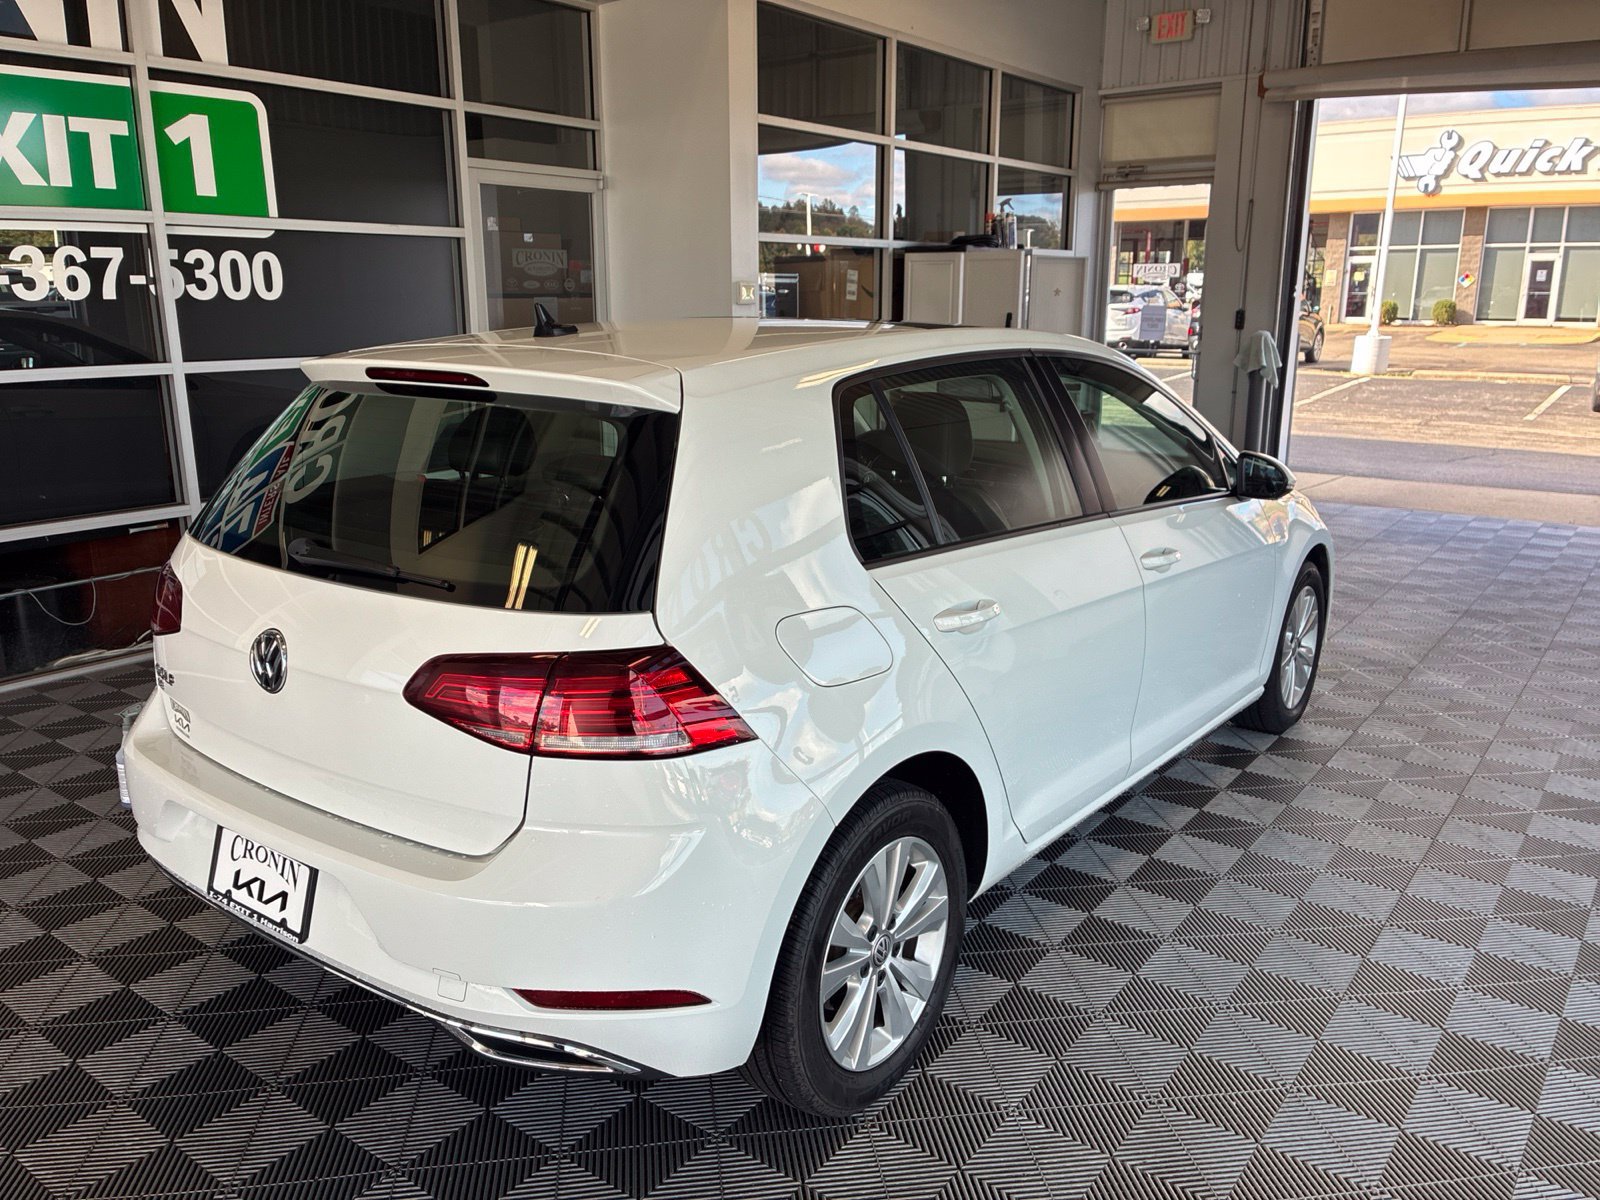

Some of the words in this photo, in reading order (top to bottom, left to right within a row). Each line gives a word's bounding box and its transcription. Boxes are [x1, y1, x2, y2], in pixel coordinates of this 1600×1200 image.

[1157, 11, 1188, 40] EXIT
[164, 113, 217, 197] 1
[1456, 138, 1595, 180] Quick
[515, 250, 564, 265] CRONIN
[231, 835, 301, 893] CRONIN
[232, 868, 289, 912] KIA
[209, 890, 228, 905] I-74
[229, 901, 252, 917] EXIT
[252, 912, 259, 921] 1
[260, 917, 299, 943] Harrison
